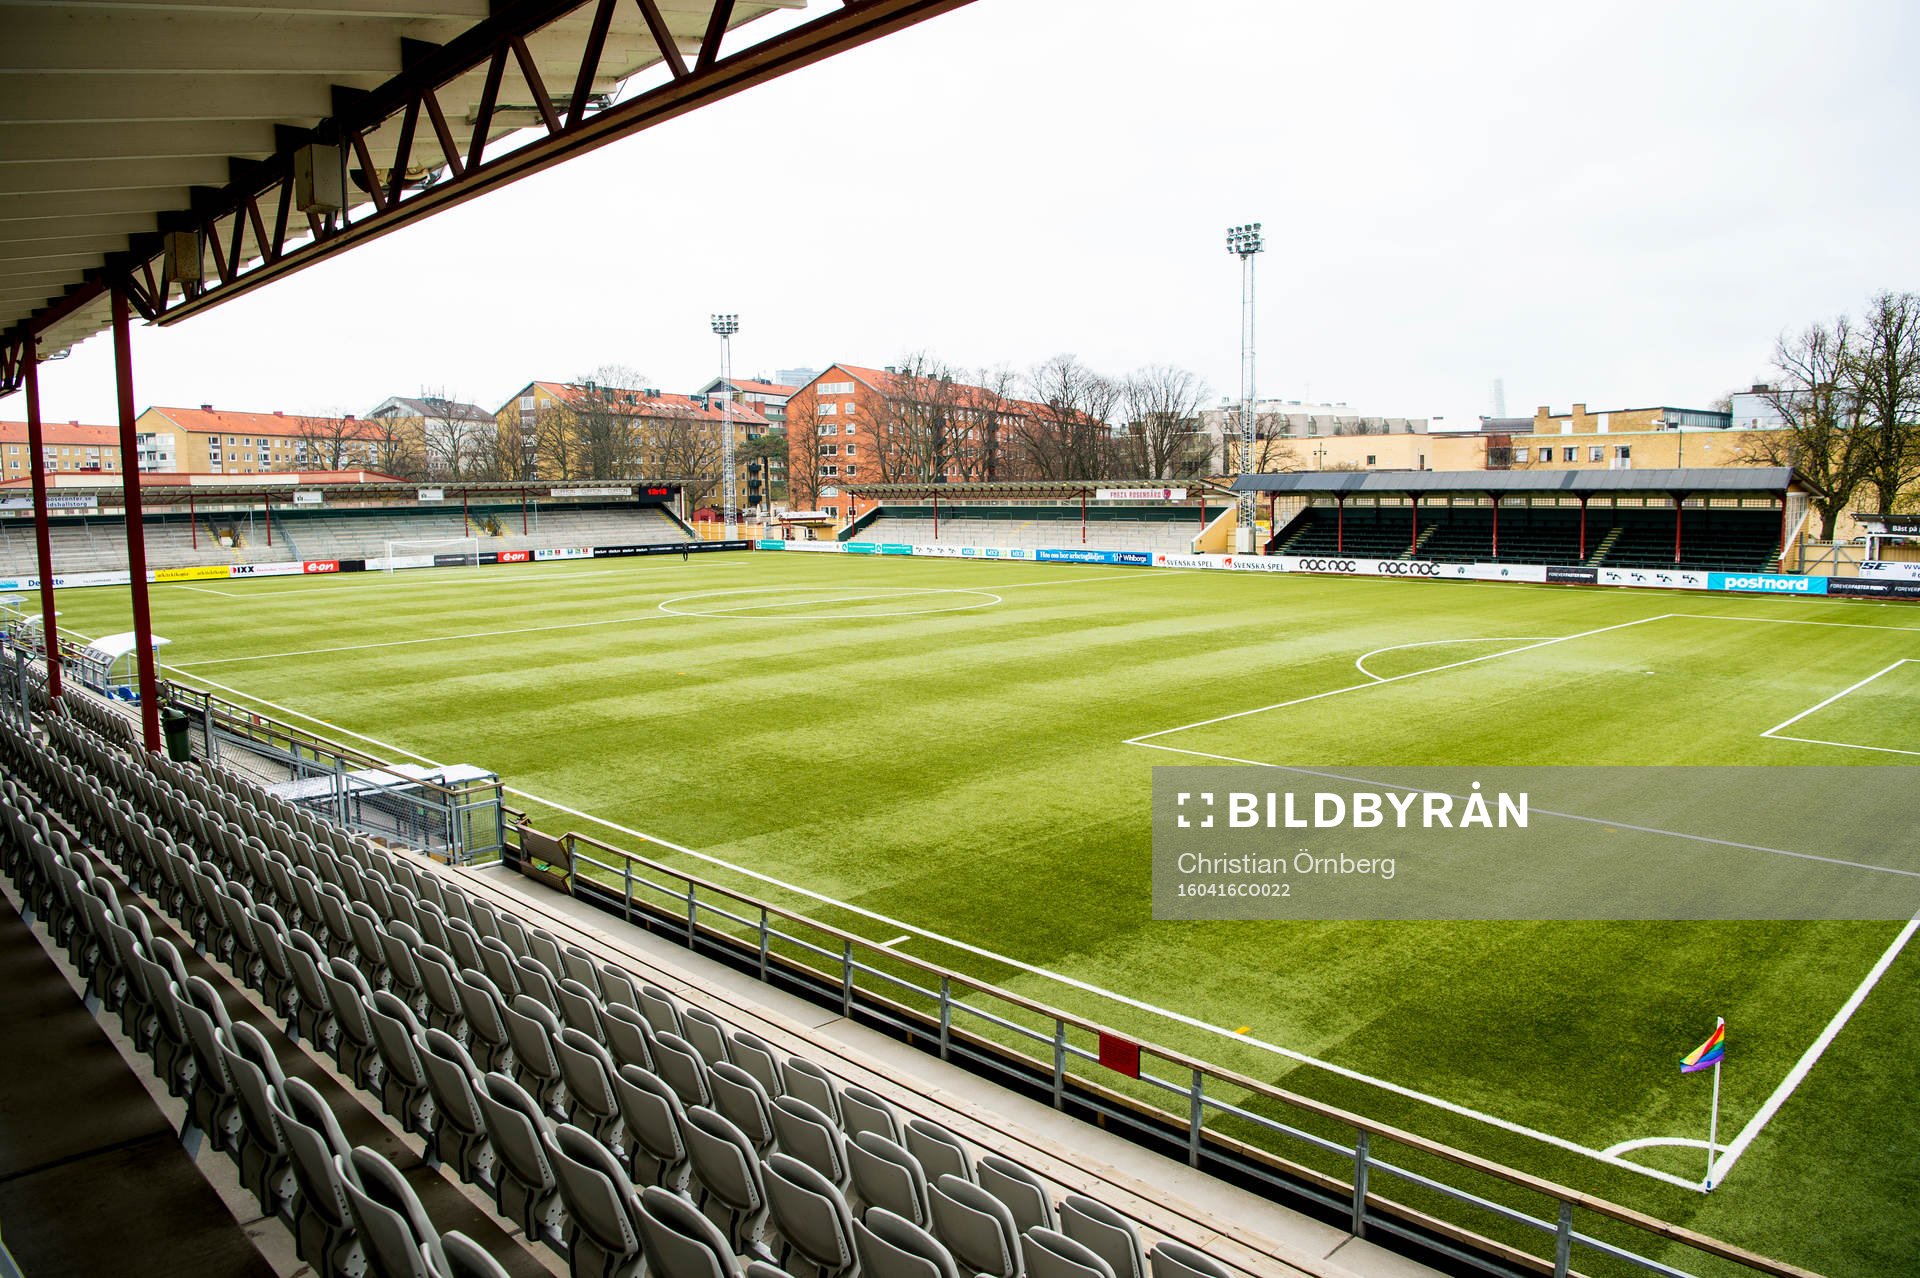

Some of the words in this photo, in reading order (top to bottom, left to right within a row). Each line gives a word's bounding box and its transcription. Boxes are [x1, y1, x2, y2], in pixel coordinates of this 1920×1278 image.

[1166, 559, 1196, 567] SVENSKA
[1198, 560, 1214, 568] SPEL
[1725, 576, 1809, 591] postnord
